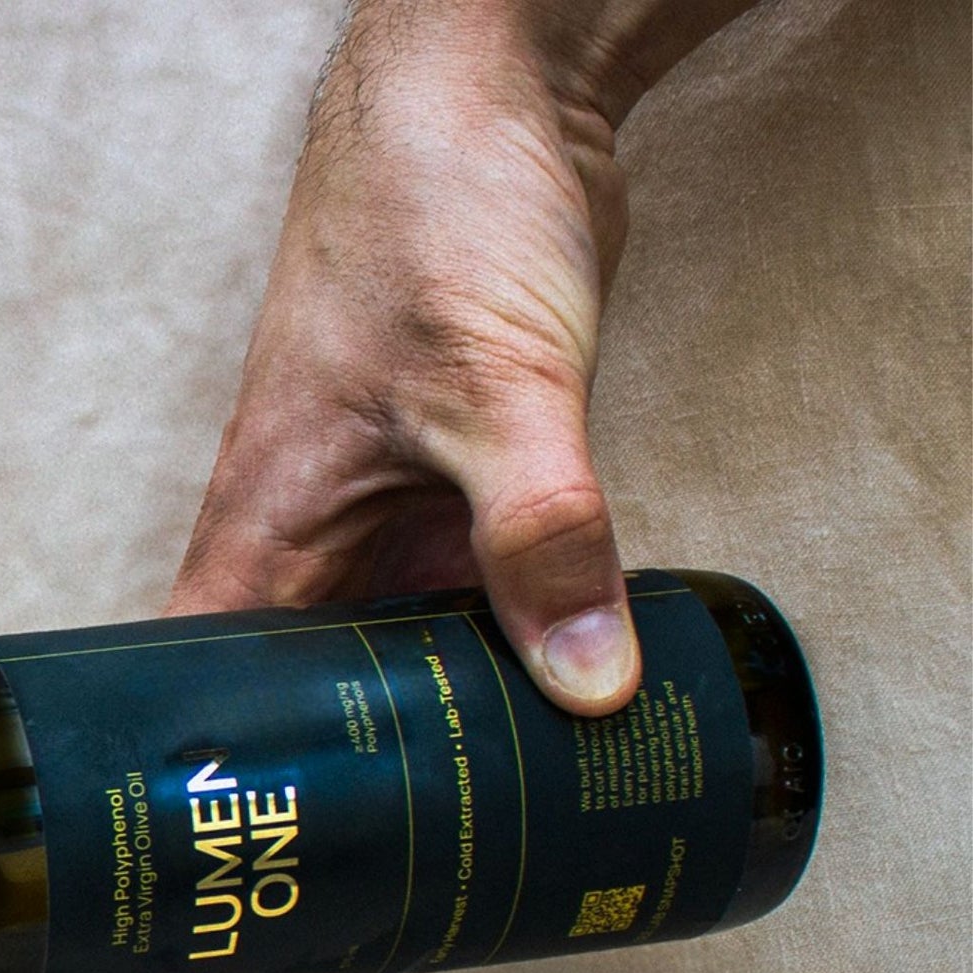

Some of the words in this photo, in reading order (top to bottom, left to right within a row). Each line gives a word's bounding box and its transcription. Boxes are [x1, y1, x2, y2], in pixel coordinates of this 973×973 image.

[424, 655, 464, 738] Lab-Tested
[654, 699, 666, 717] for
[662, 680, 678, 704] and
[350, 680, 379, 753] Polyphenols
[629, 715, 642, 739] and
[617, 728, 632, 767] batch
[634, 742, 648, 784] purity
[658, 719, 677, 801] polyphenols
[690, 735, 704, 798] metabolic
[126, 771, 146, 798] Oil
[578, 758, 591, 788] built
[593, 770, 605, 793] cut
[621, 770, 635, 806] Every
[648, 737, 662, 803] delivering
[453, 756, 473, 840] Extracted
[580, 791, 592, 812] We
[595, 796, 605, 810] to
[608, 795, 619, 808] of
[635, 788, 647, 804] for
[105, 788, 133, 901] Polyphenol
[134, 801, 152, 851] Olive
[183, 746, 243, 960] LUMEN
[245, 786, 299, 918] ONE
[457, 842, 473, 881] Cold
[137, 854, 158, 909] Virgin
[656, 836, 686, 911] SNAPSHOT
[111, 905, 134, 946] High
[133, 910, 153, 954] Extra
[443, 894, 468, 942] Harvest
